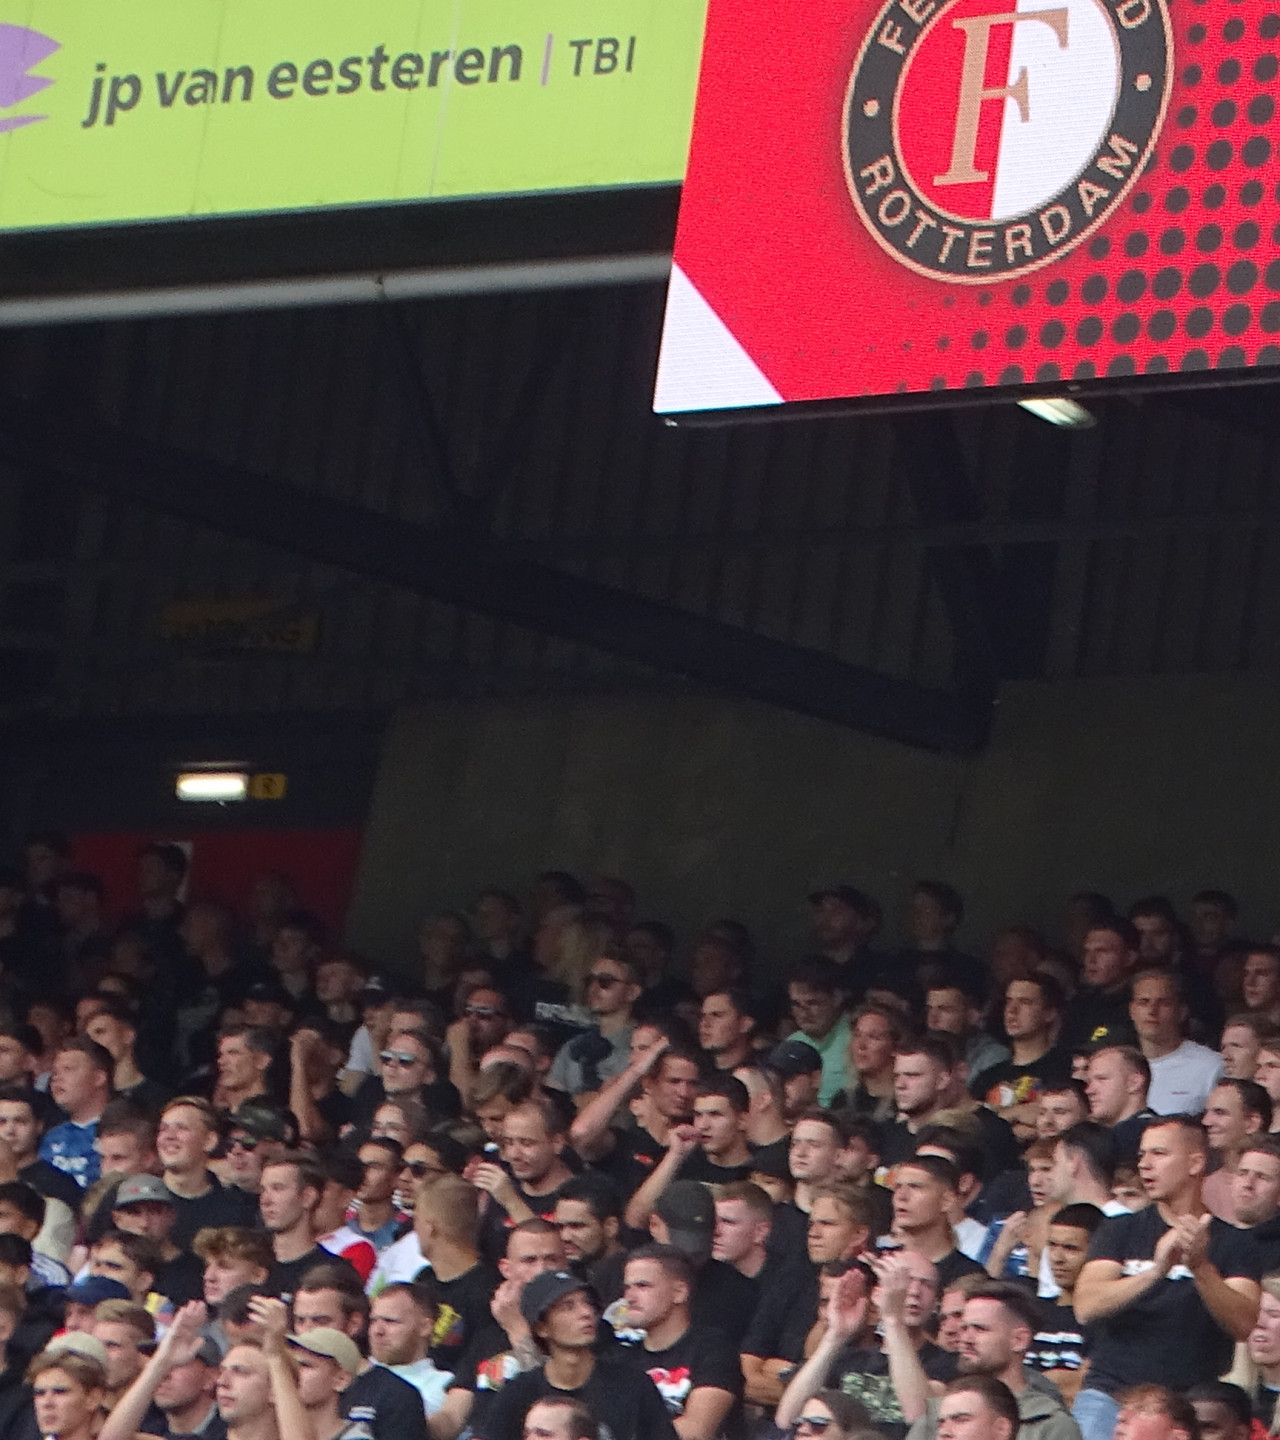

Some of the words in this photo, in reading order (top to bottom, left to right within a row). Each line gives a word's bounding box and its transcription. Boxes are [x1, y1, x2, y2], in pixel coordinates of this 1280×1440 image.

[81, 62, 142, 129] jp
[155, 64, 254, 108] van
[266, 42, 524, 100] eesteren
[568, 35, 637, 77] TBI
[933, 6, 1070, 186] F
[860, 133, 1140, 268] ROTTERDAM
